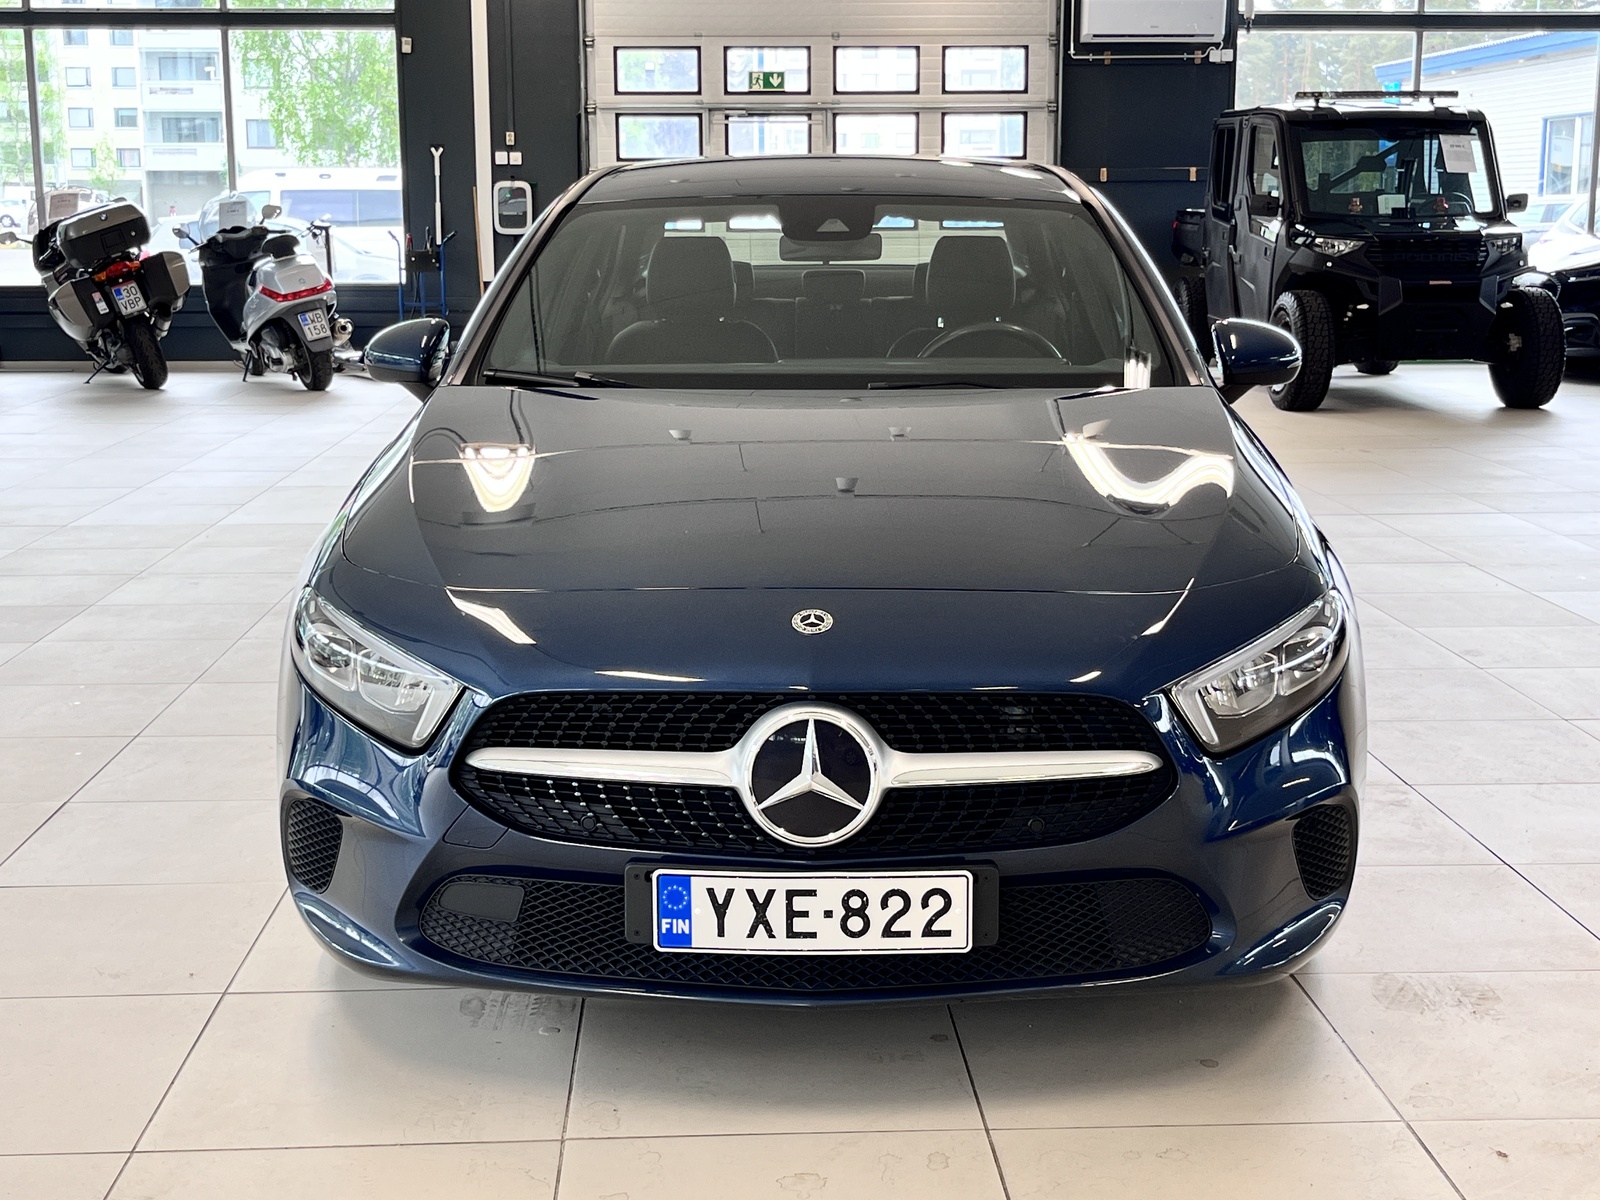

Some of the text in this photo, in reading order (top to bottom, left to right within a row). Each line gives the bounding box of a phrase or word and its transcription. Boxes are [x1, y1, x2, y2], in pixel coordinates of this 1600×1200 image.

[122, 285, 138, 298] 30
[120, 296, 141, 311] VBP
[307, 323, 328, 337] 158
[661, 887, 953, 940] FIN YXE-822
